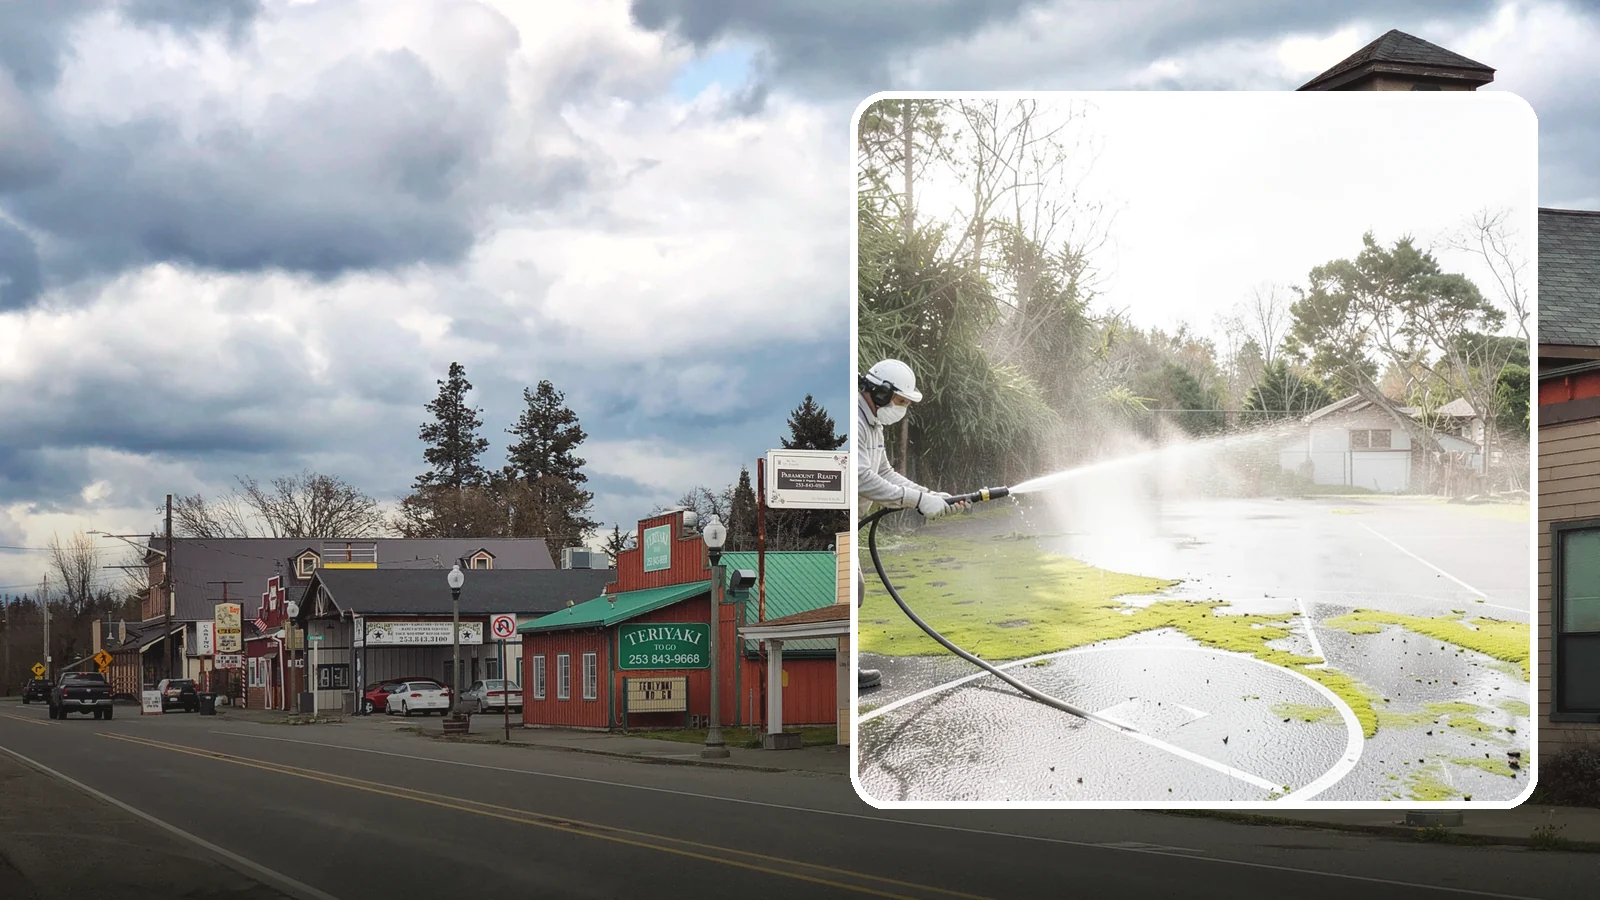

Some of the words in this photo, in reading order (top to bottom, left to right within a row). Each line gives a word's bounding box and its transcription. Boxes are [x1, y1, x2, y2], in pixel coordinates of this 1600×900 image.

[625, 628, 702, 645] TERIYAKI
[628, 654, 649, 665] 253
[651, 654, 700, 664] 843-9668
